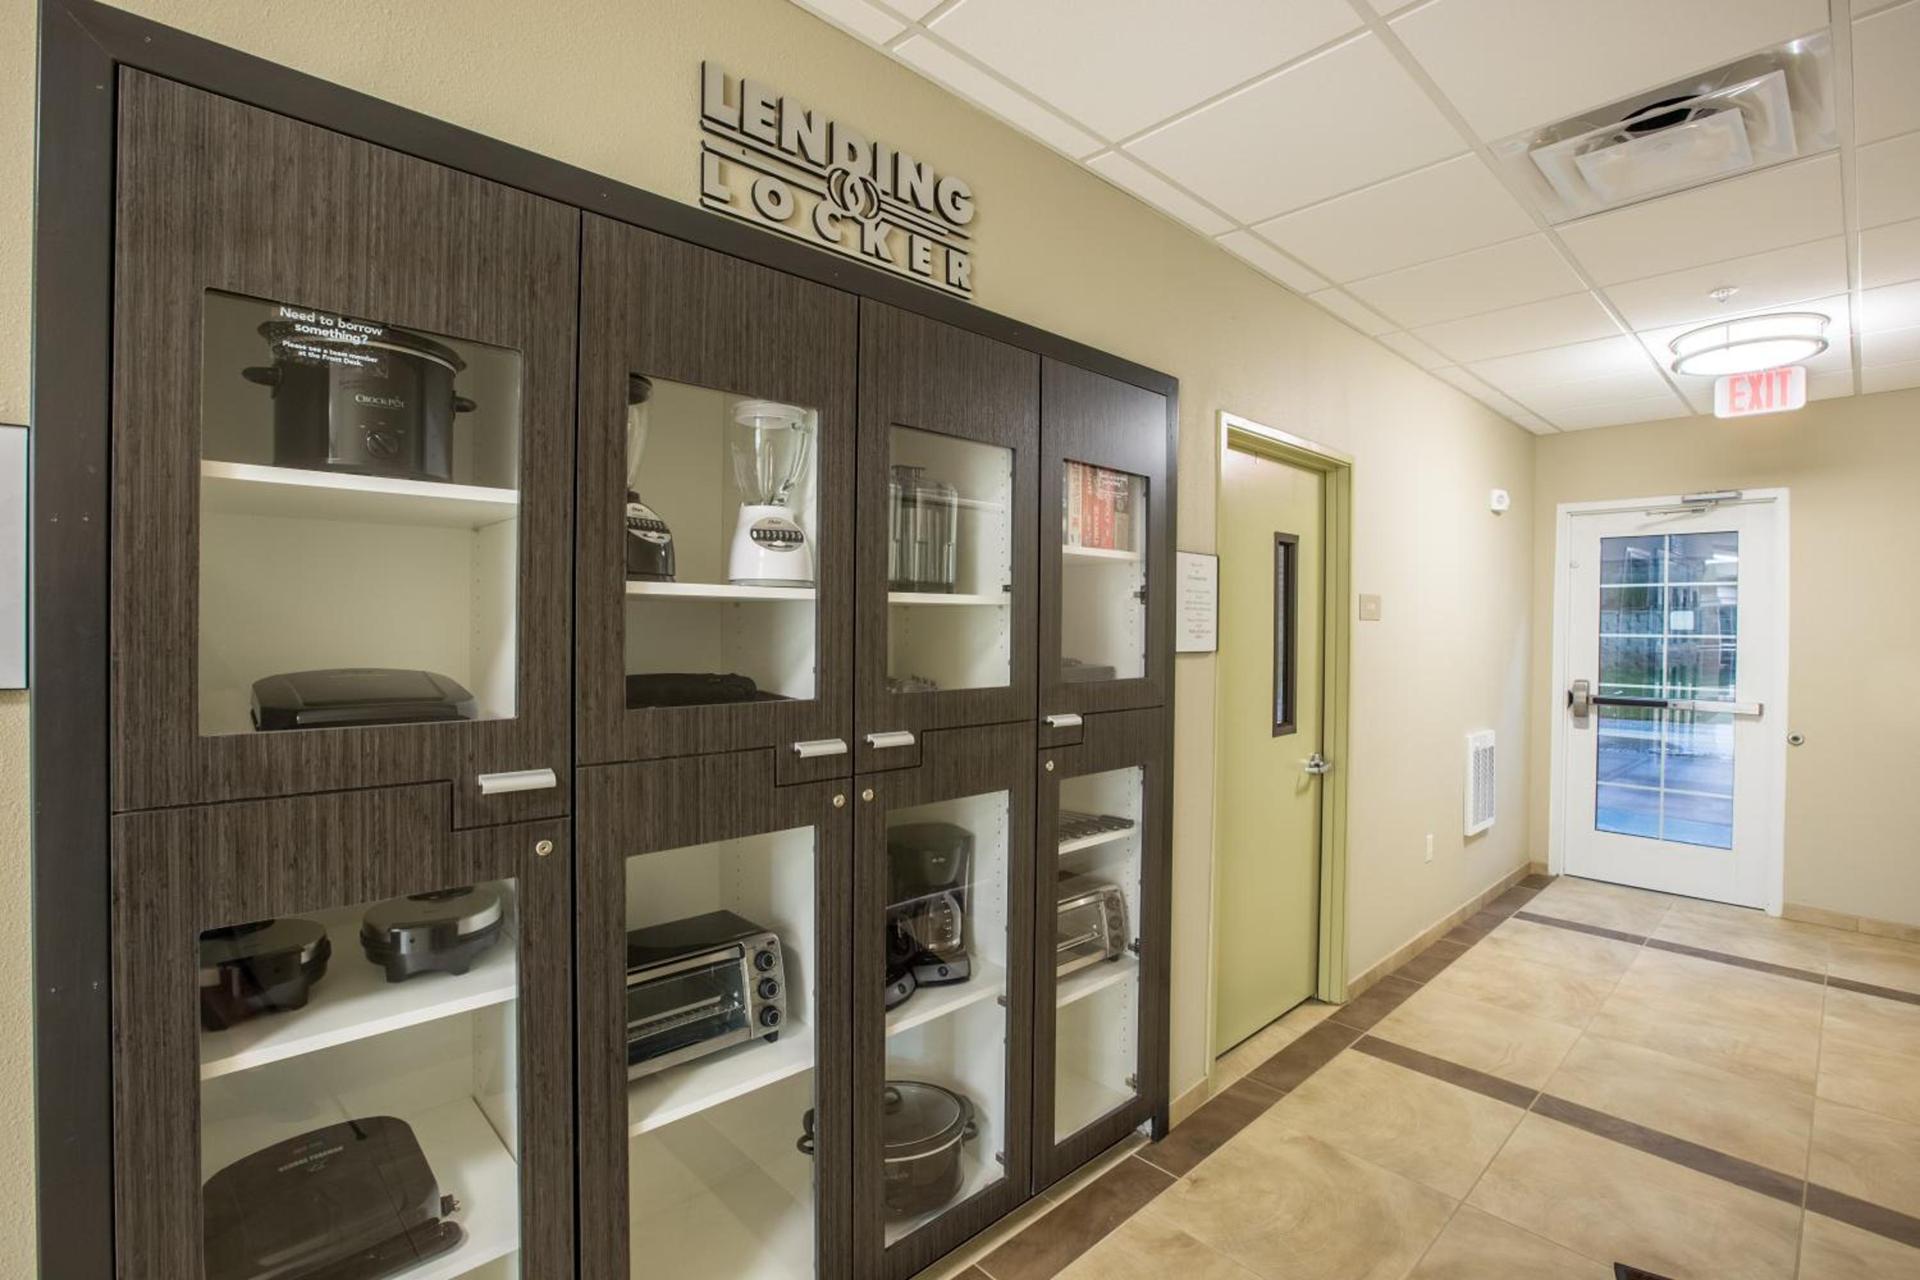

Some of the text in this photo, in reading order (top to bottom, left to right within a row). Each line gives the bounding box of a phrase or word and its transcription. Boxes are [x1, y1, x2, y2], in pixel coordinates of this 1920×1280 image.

[700, 60, 976, 226] LENDING
[700, 151, 974, 292] LOCKER
[280, 306, 383, 336] Need to borrow
[295, 323, 369, 345] something?
[349, 354, 378, 363] member
[1728, 366, 1793, 412] EXIT
